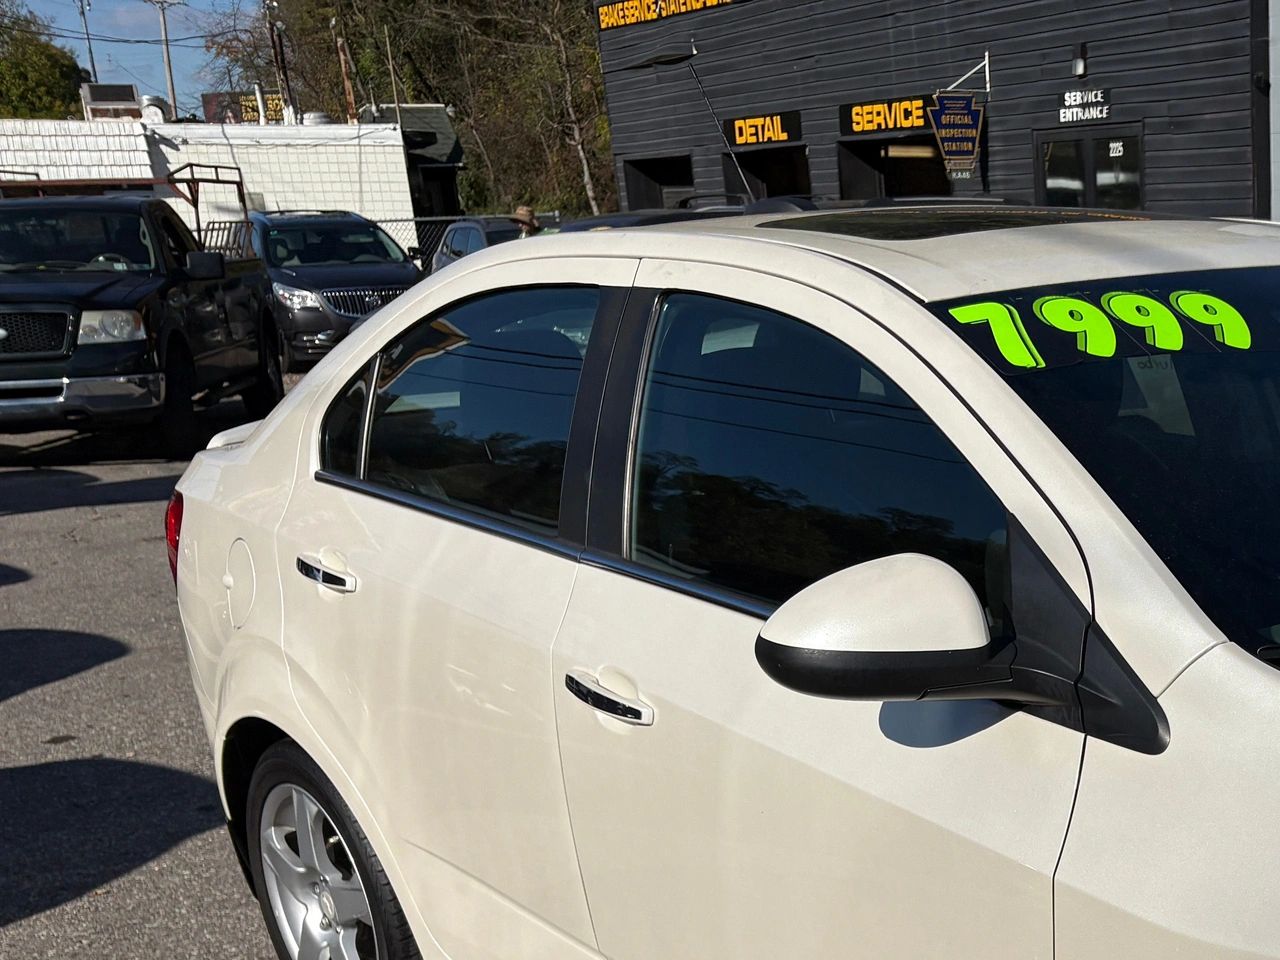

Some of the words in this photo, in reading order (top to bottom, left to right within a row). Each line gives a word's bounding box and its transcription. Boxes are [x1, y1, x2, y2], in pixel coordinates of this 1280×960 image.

[1063, 90, 1105, 106] SERVICE
[851, 100, 925, 132] SERVICE
[1059, 106, 1110, 122] ENTRANCE
[734, 116, 788, 145] DETAIL
[948, 290, 1252, 368] 7999
